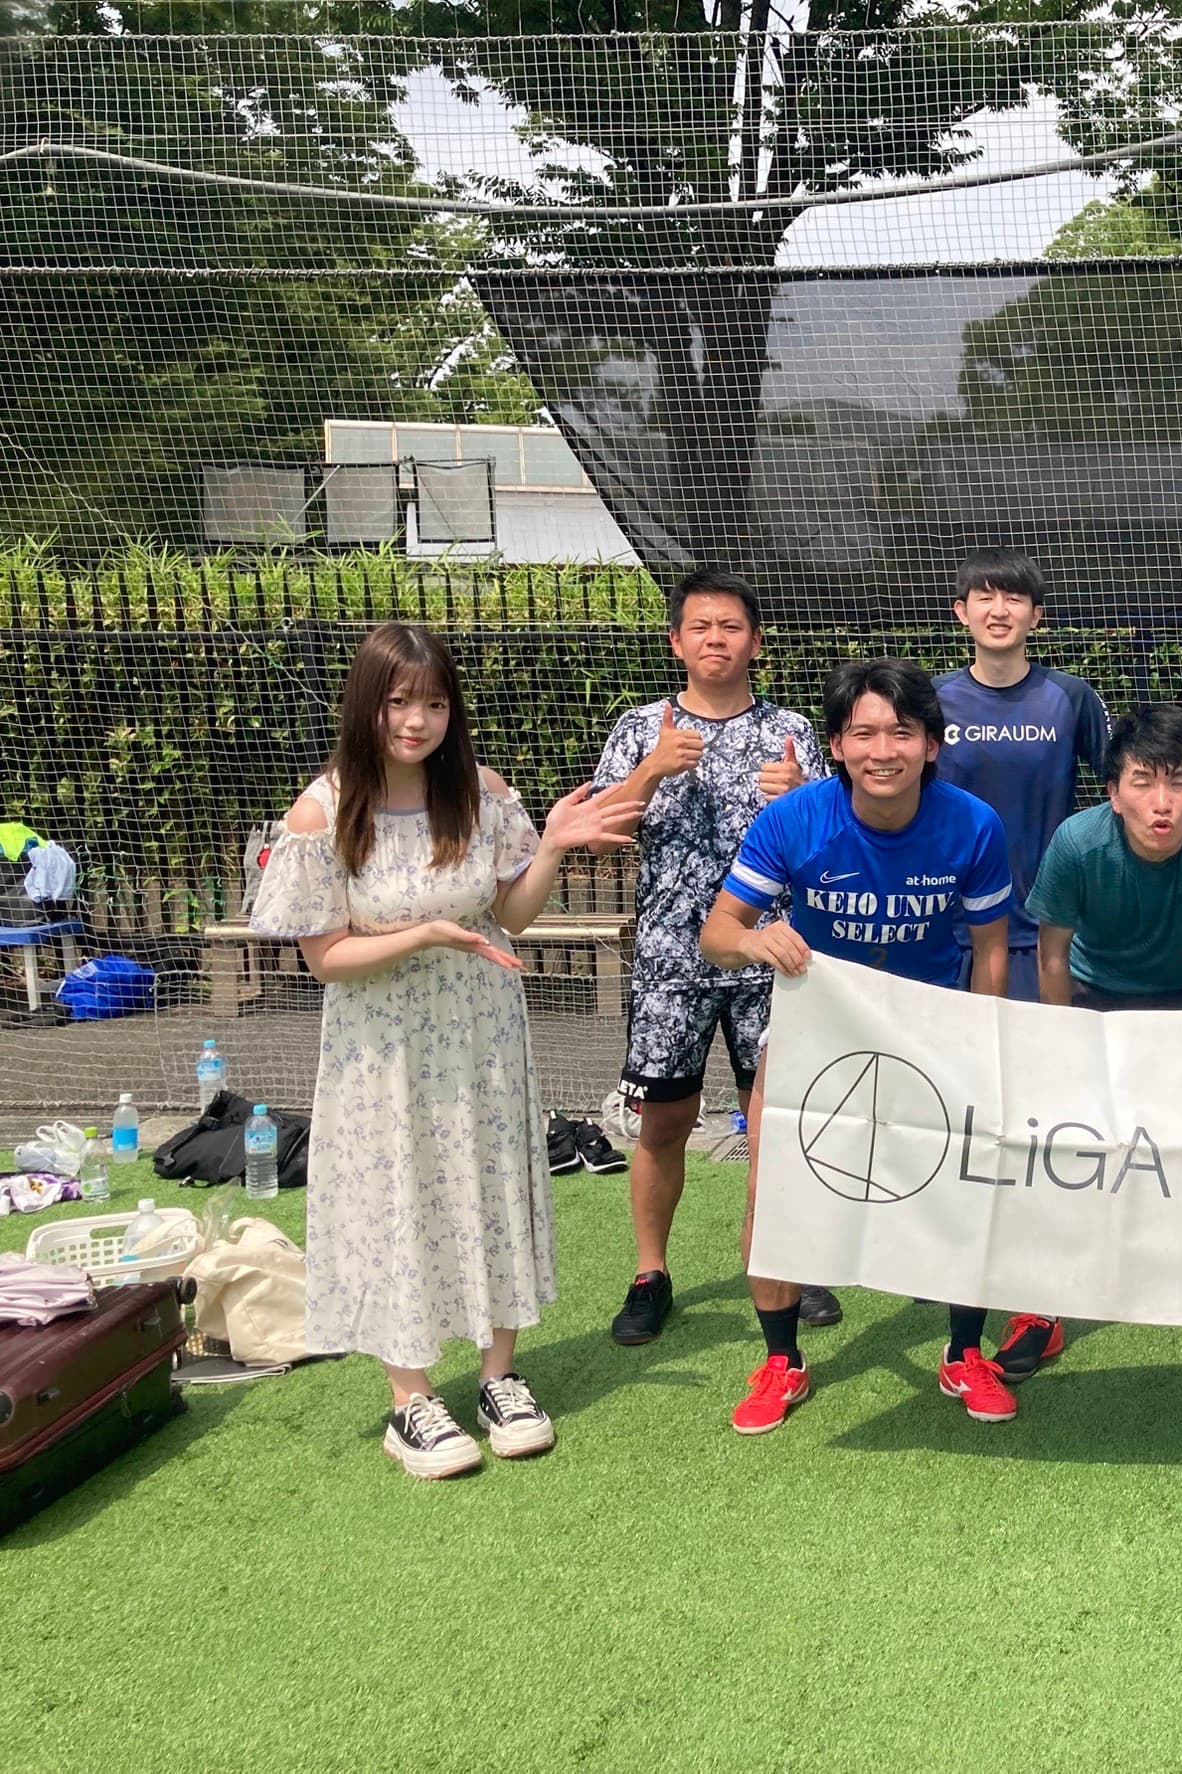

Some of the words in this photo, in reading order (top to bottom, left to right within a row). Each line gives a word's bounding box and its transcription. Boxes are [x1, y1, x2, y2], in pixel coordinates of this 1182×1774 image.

[964, 725, 1056, 742] GIRAUDM
[905, 876, 920, 886] at
[921, 874, 957, 886] home
[805, 888, 878, 916] KEIO
[832, 920, 930, 944] SELECT
